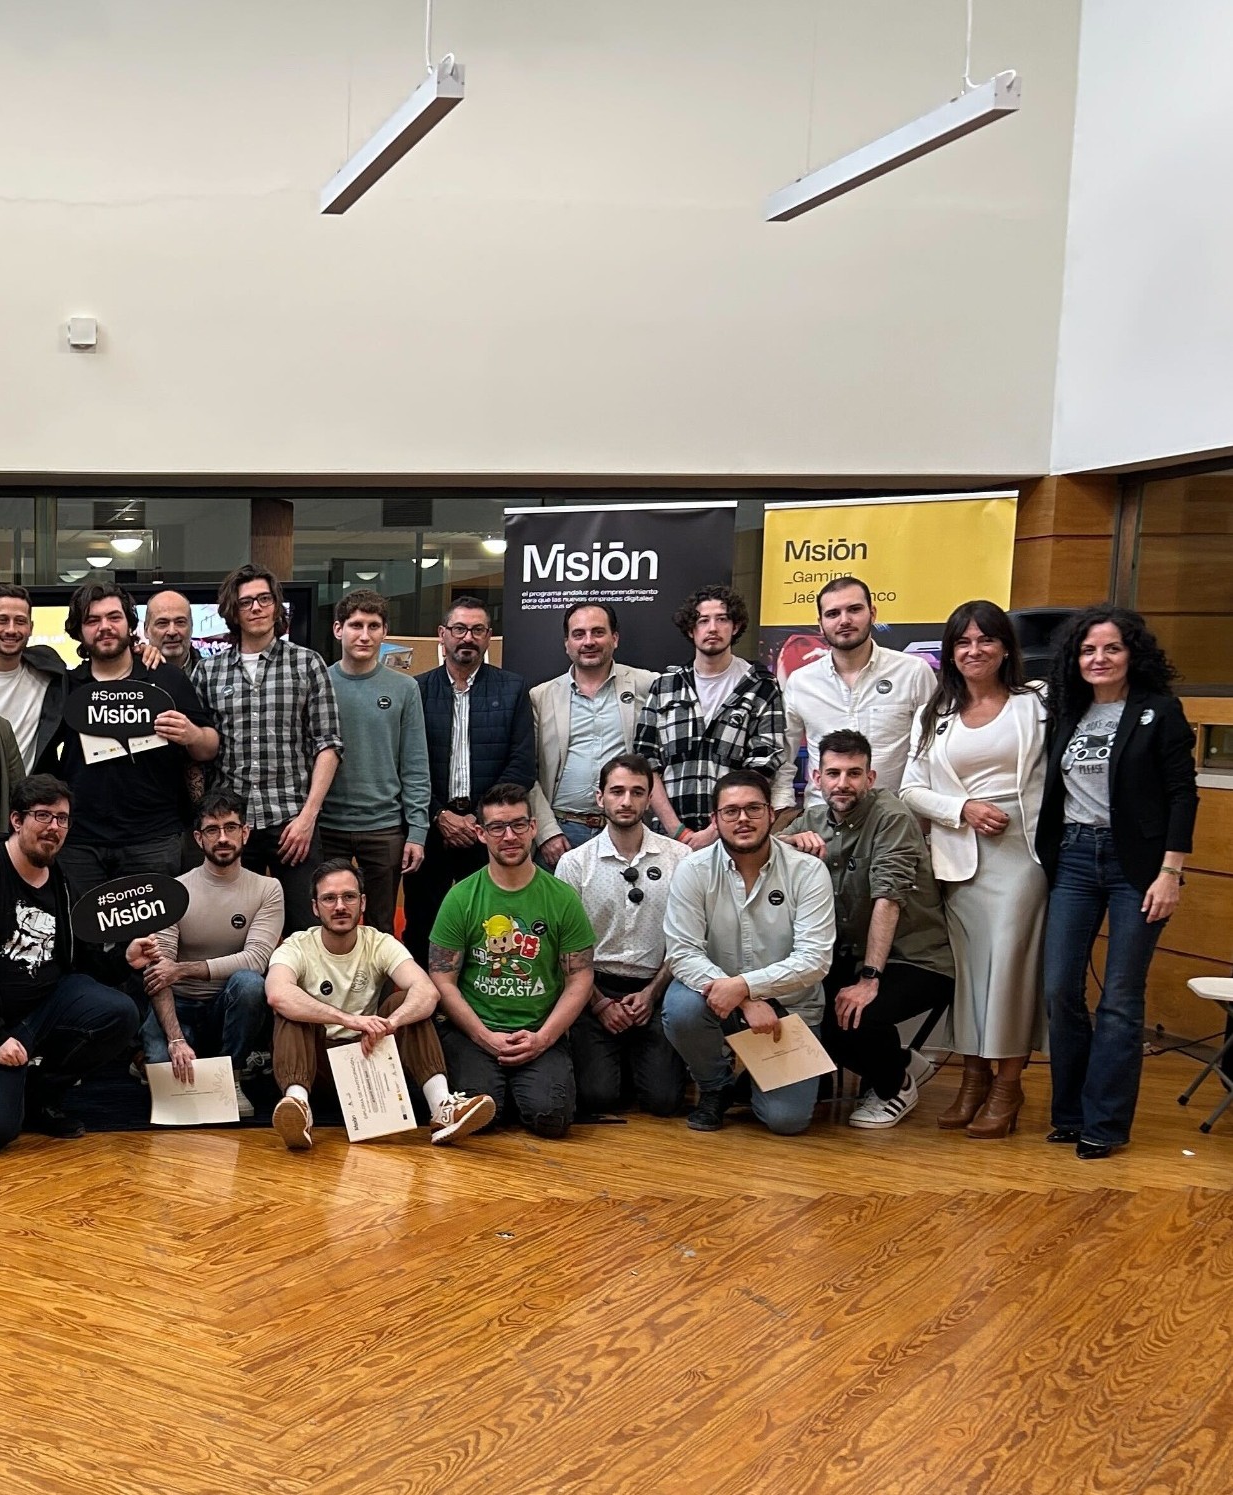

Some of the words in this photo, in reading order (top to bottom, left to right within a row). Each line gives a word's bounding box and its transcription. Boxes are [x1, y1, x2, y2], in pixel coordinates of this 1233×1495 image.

[91, 690, 144, 701] #Somos
[1078, 764, 1105, 775] PLEASE
[97, 883, 154, 906] #Somos
[481, 975, 499, 986] LINK
[501, 977, 514, 986] TO
[516, 977, 533, 986] THE
[473, 980, 533, 997] PODCAST
